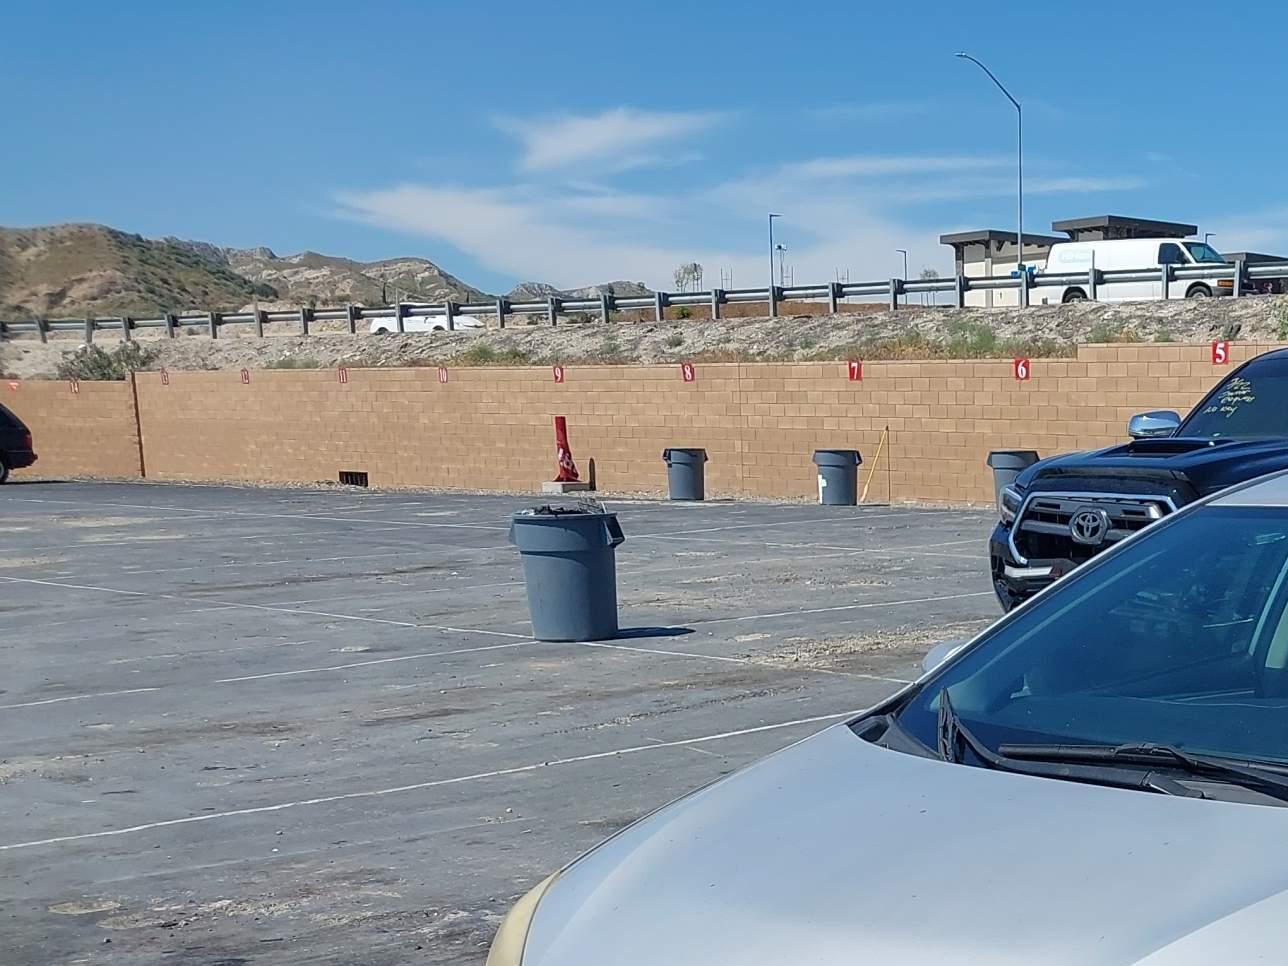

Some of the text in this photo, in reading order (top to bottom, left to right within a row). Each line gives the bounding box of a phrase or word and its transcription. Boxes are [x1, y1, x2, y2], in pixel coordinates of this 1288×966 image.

[1215, 342, 1226, 363] 5
[554, 367, 562, 381] 9
[684, 364, 692, 380] 8
[850, 362, 858, 380] 7
[1017, 360, 1026, 379] 6
